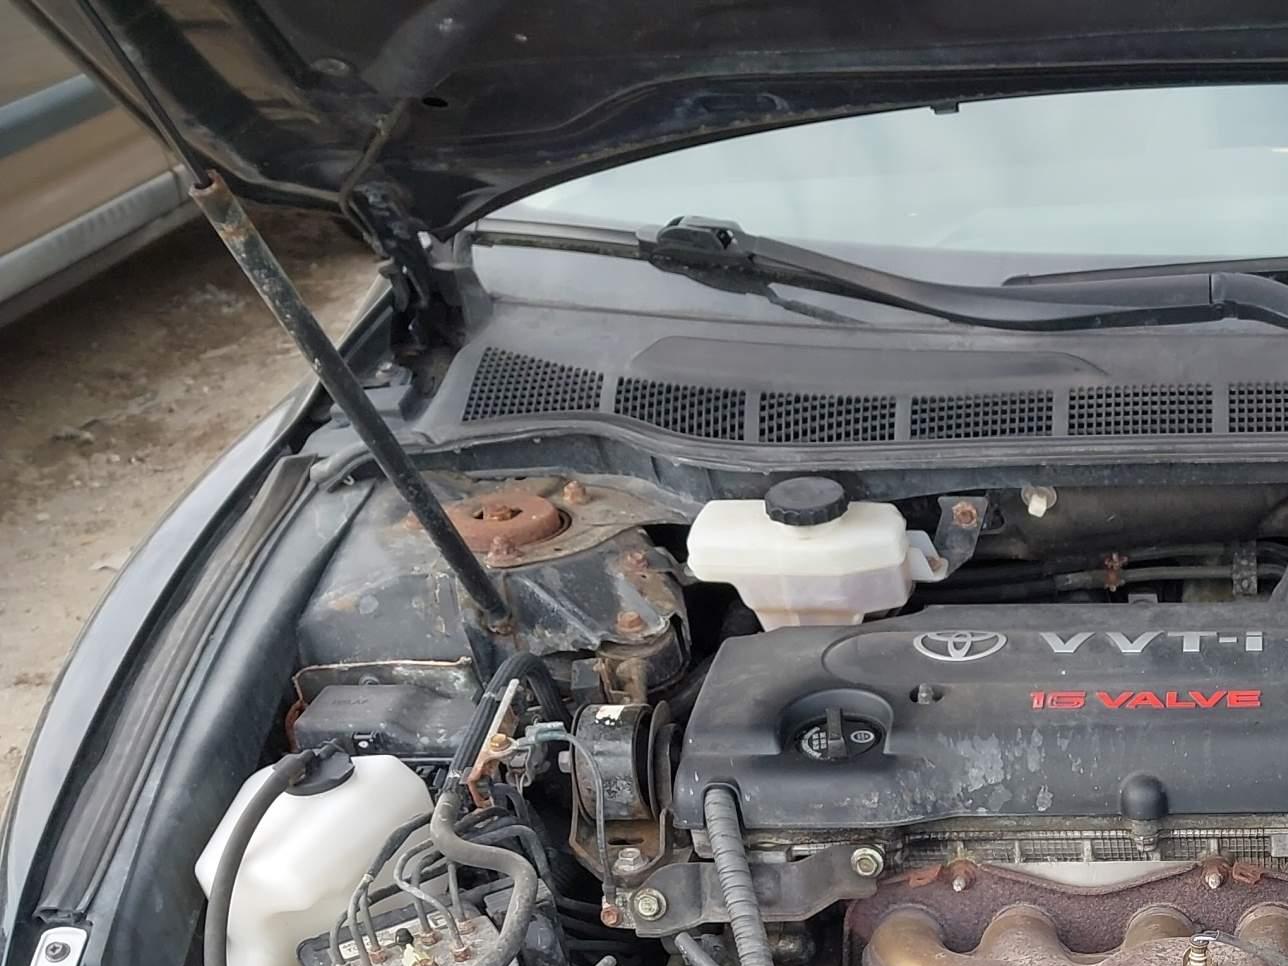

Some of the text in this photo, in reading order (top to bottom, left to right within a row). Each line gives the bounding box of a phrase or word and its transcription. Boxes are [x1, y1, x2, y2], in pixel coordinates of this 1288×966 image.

[1039, 631, 1264, 653] VVT-i
[1029, 690, 1263, 710] 16 VALVE
